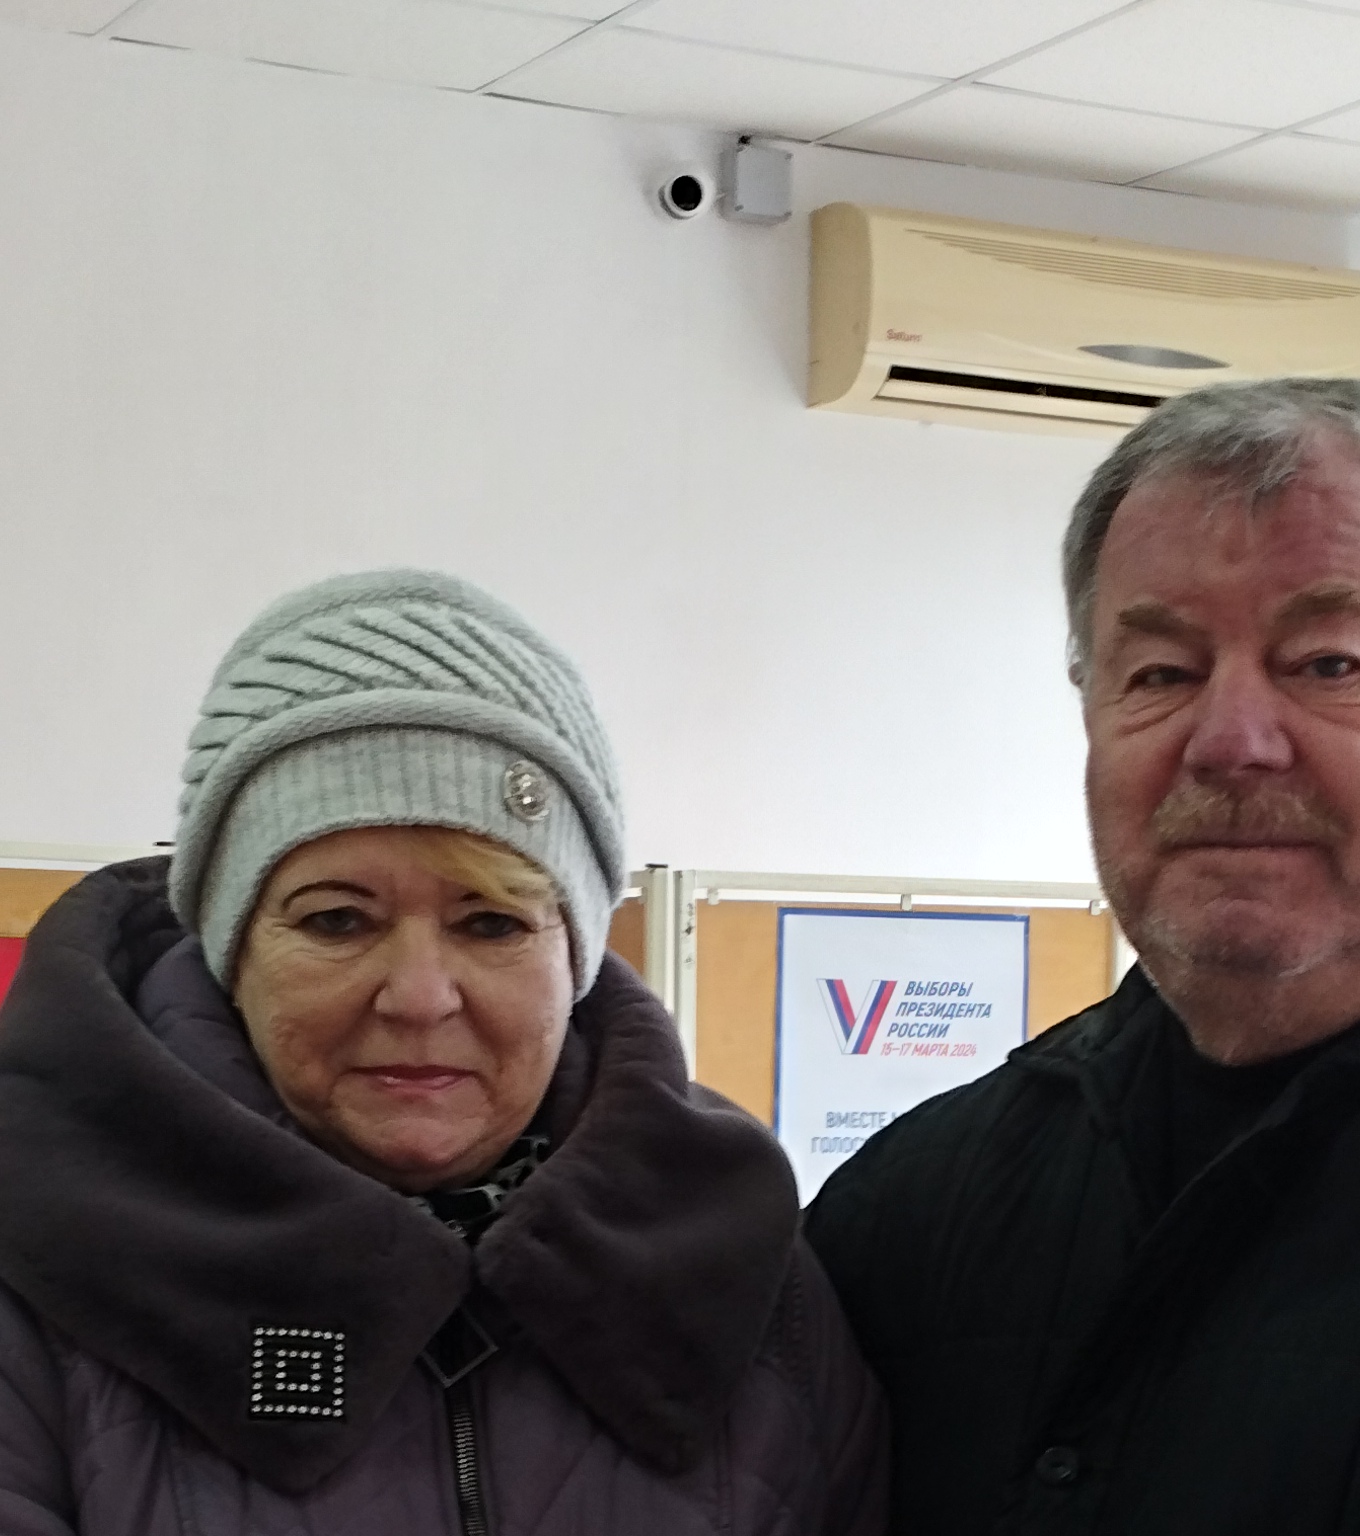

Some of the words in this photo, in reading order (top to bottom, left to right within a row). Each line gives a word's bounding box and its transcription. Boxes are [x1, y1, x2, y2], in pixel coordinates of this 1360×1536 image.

[904, 980, 974, 997] ВЫБОРЫ
[895, 1001, 993, 1020] ПРЕЗИДЕНТА
[887, 1022, 950, 1038] РОССИИ
[911, 1043, 950, 1057] МАРТА
[950, 1043, 977, 1057] 2024
[826, 1111, 887, 1128] ВМЕСТЕ
[811, 1136, 864, 1153] ГОЛОС
